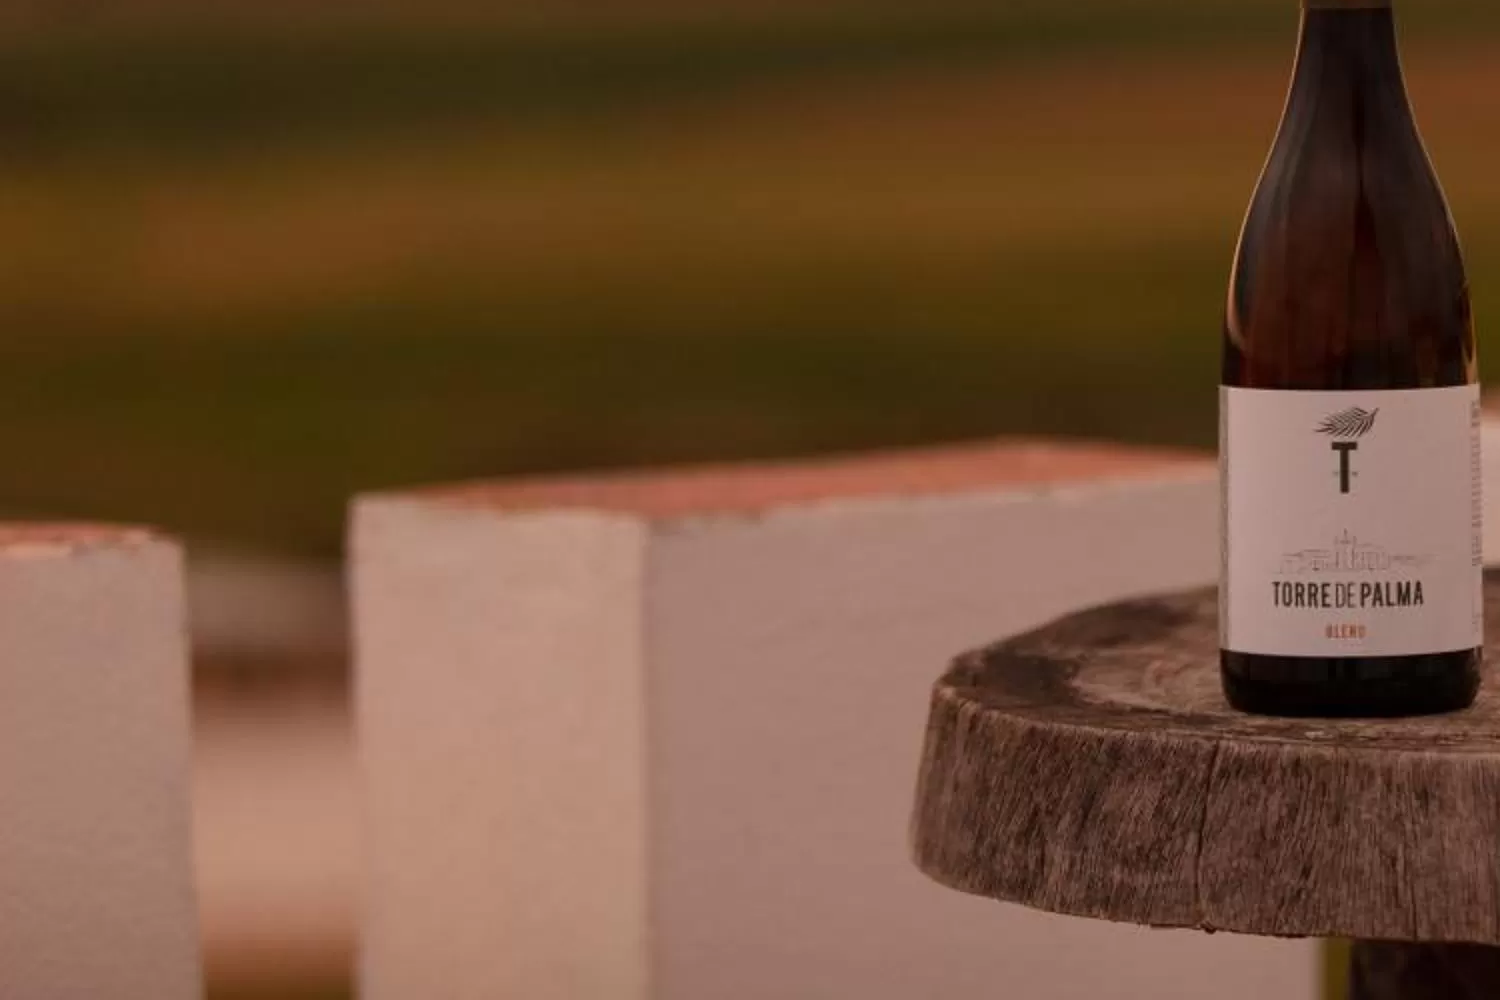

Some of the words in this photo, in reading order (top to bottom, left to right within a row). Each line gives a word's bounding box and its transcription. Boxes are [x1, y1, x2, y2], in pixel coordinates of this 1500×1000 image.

[1331, 441, 1358, 494] T
[1272, 581, 1331, 609] TORRE
[1335, 583, 1357, 609] DE
[1360, 580, 1424, 608] PALMA
